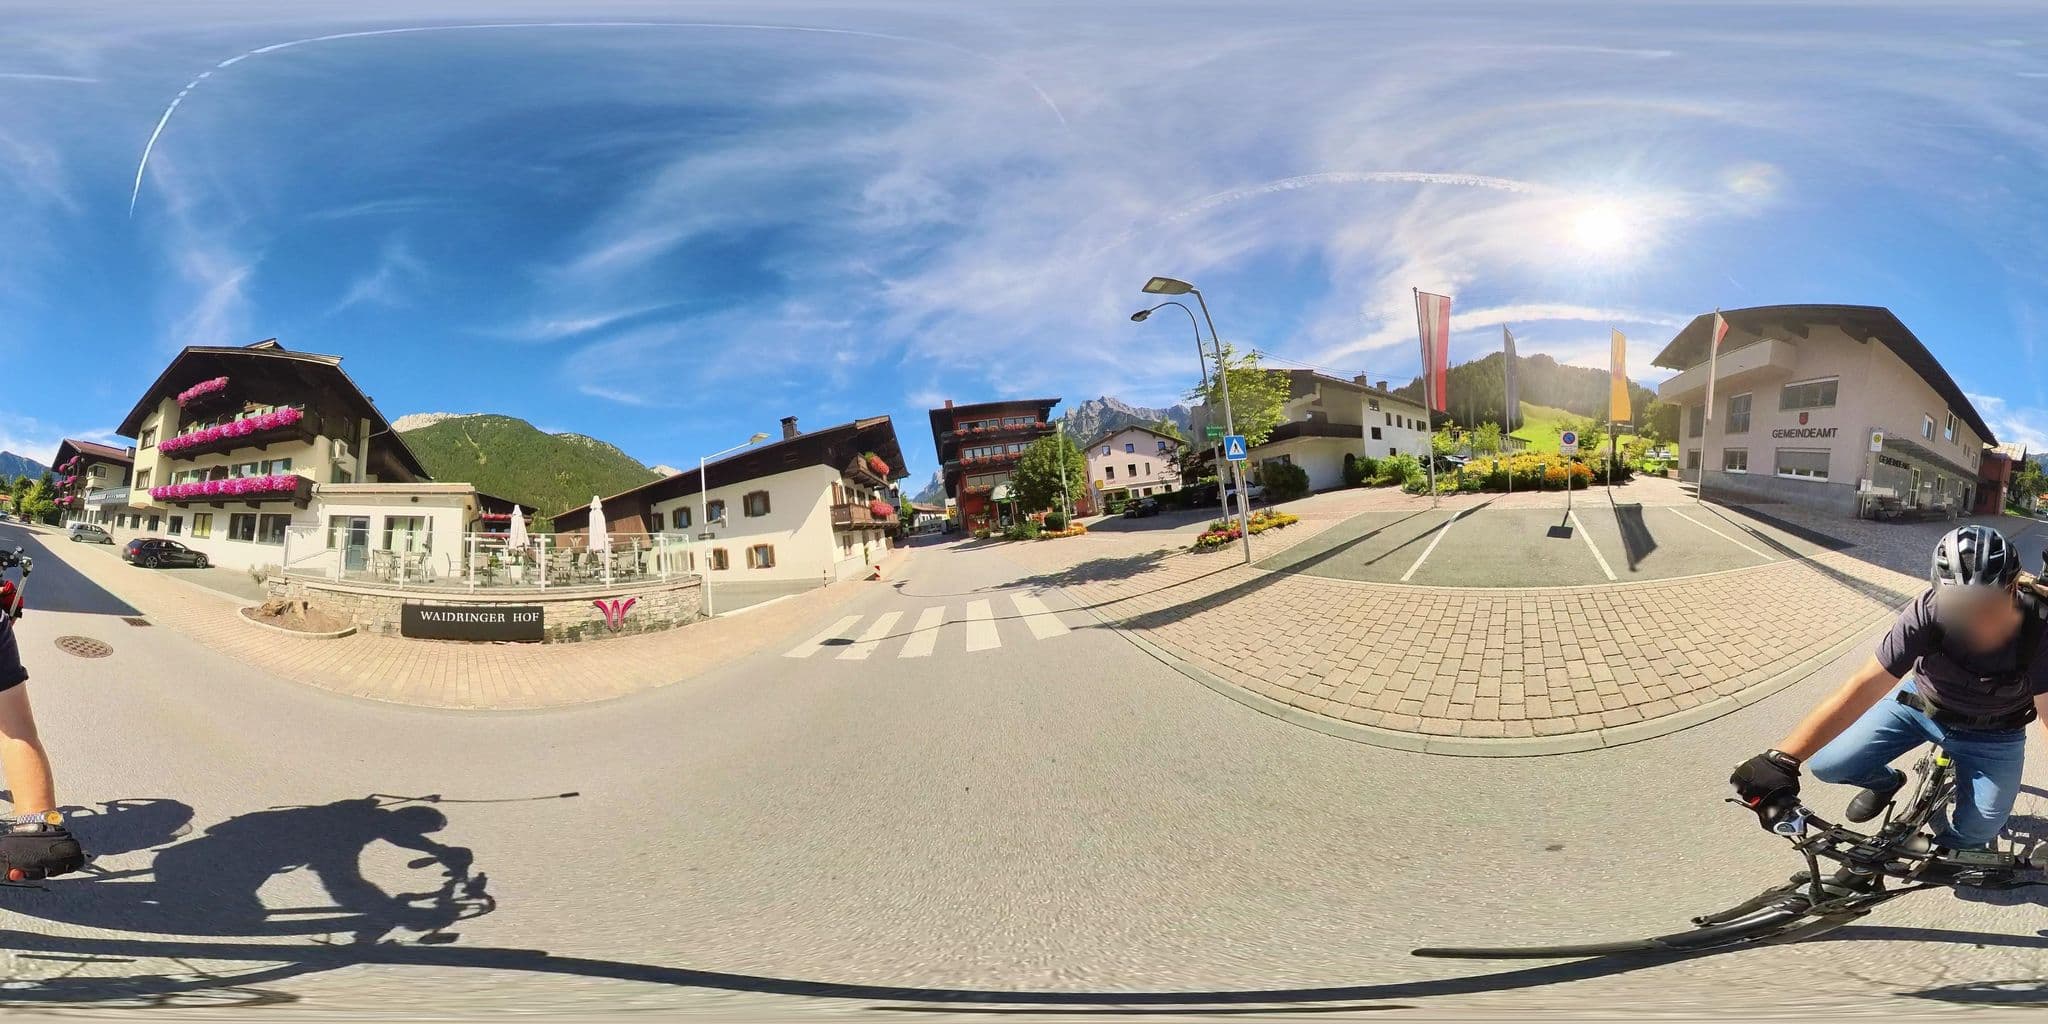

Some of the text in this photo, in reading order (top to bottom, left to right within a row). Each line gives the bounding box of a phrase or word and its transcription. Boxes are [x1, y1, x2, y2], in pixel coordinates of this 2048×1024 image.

[1772, 427, 1838, 439] GEMEINDEAMT
[420, 611, 540, 623] WAIDRINGER HOF
